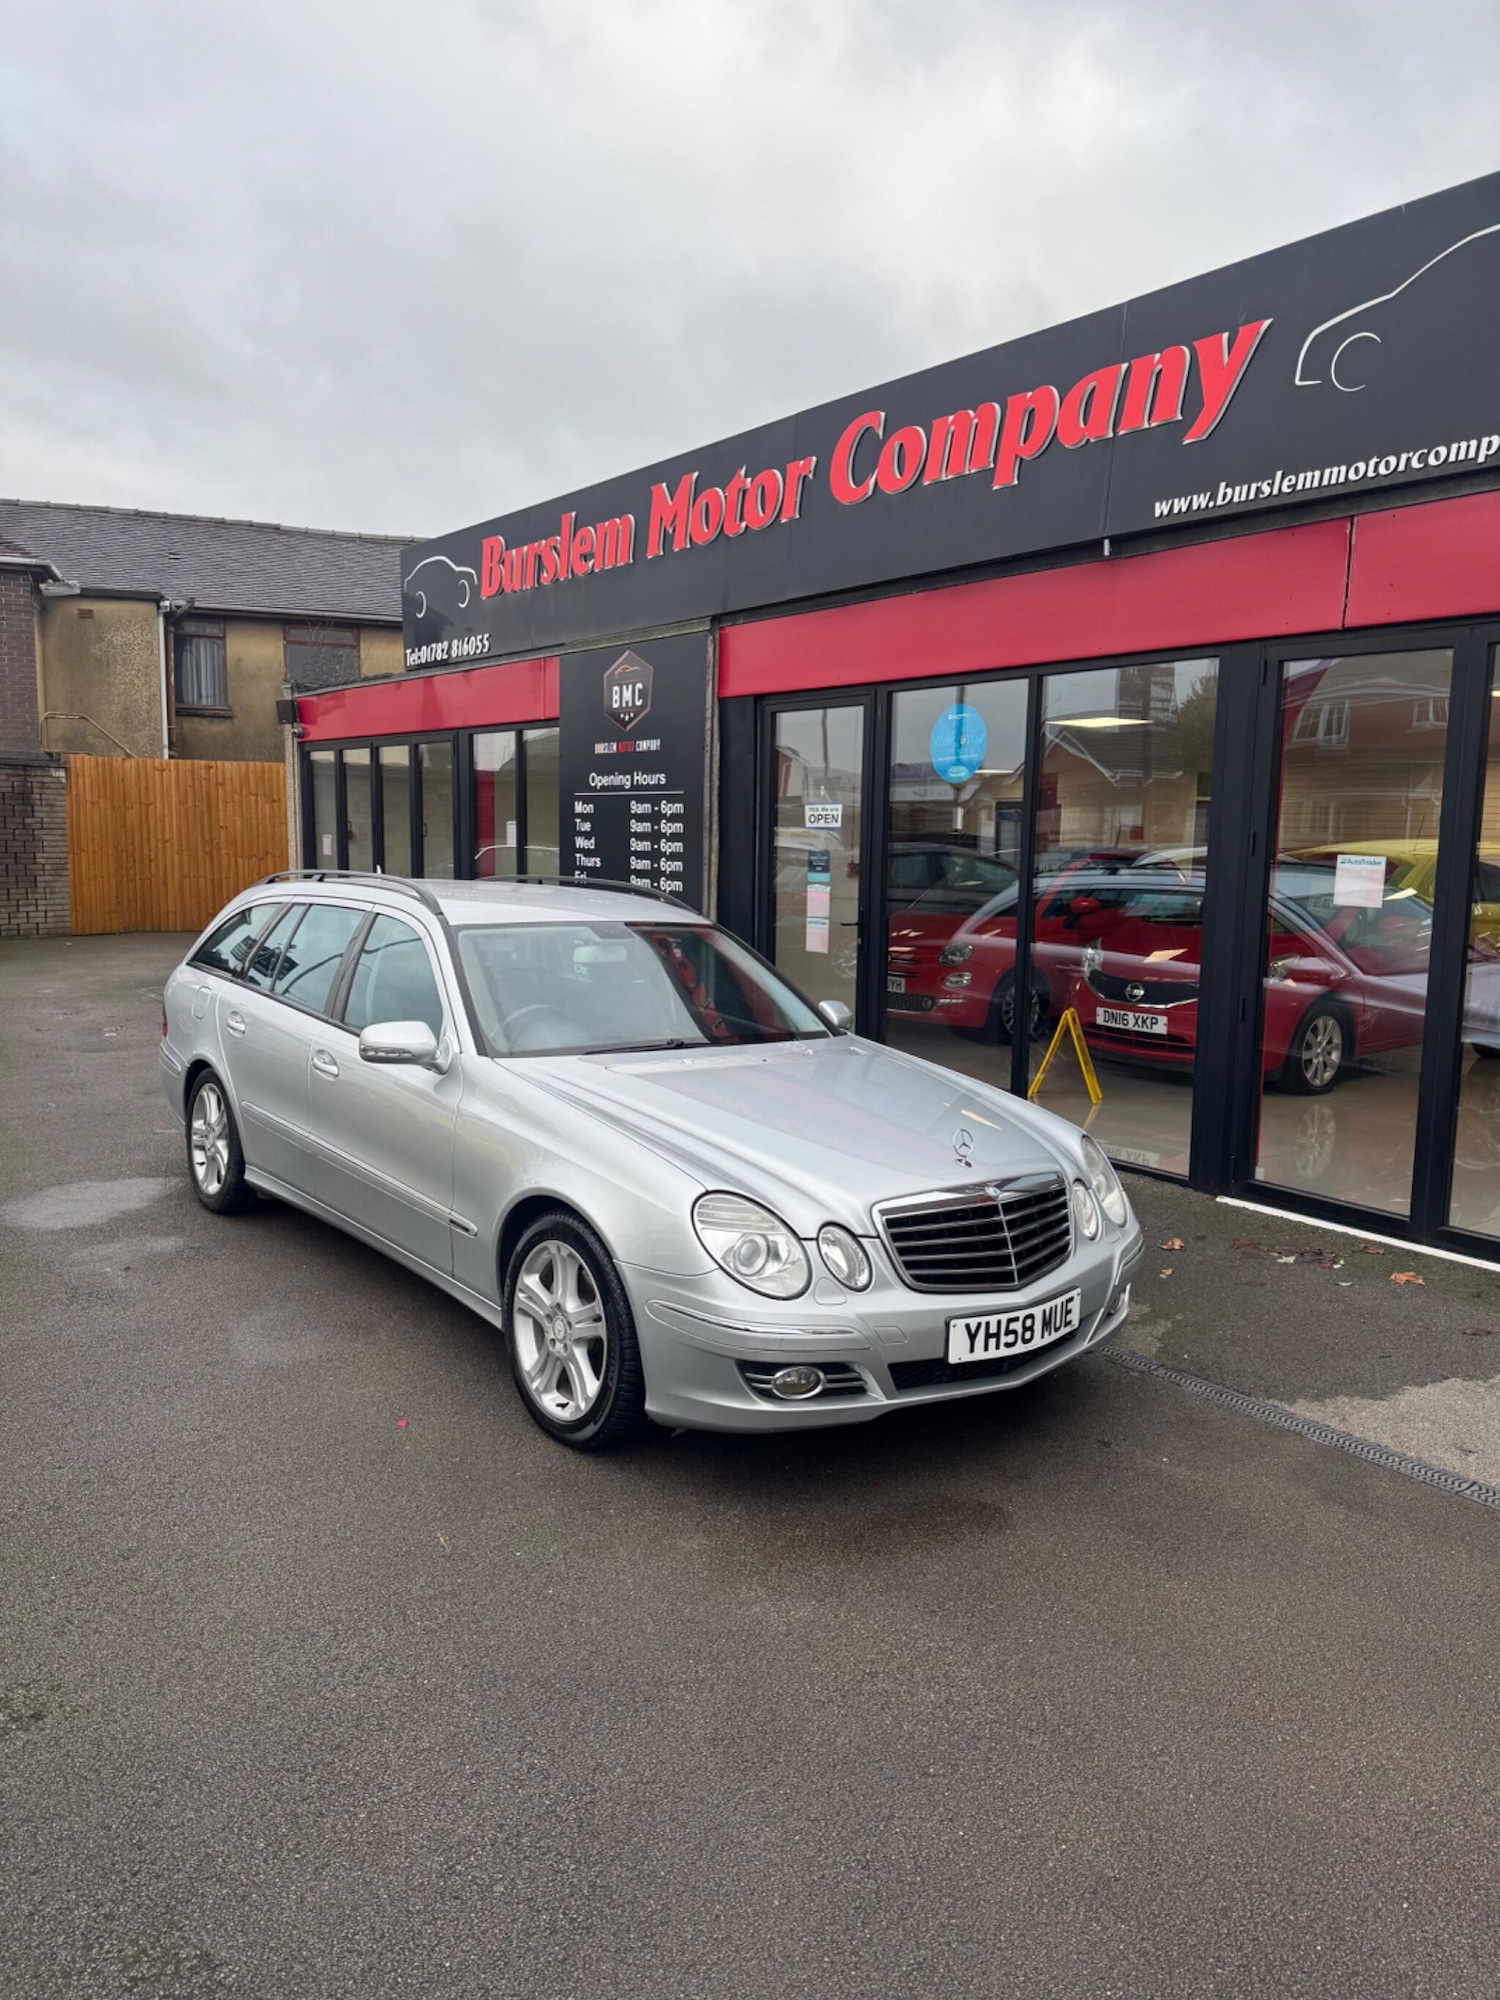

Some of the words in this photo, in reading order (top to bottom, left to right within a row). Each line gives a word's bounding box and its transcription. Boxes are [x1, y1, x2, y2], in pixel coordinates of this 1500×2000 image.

[479, 511, 636, 600] Burslem
[645, 456, 818, 560] Motor
[829, 317, 1275, 506] Company
[406, 641, 449, 667] Tel:01782
[451, 633, 491, 658] 816055
[612, 682, 643, 709] BMC
[588, 771, 632, 790] Opening
[633, 770, 667, 786] Hours
[574, 801, 595, 814] Mon
[629, 800, 652, 814] 9am
[660, 800, 684, 817] 6pm
[808, 813, 840, 824] OPEN
[574, 818, 592, 832] Tue
[629, 819, 652, 832] 9am
[660, 819, 684, 836] 6pm
[574, 836, 596, 849] Wed
[629, 838, 652, 852] 9am
[660, 839, 684, 855] 6pm
[574, 853, 601, 867] Thurs
[629, 856, 652, 870] 9am
[660, 857, 684, 874] 6pm
[629, 875, 652, 889] 9am
[660, 877, 684, 893] 6pm
[1103, 1009, 1130, 1027] DN16
[1132, 1013, 1159, 1031] XKP
[964, 1312, 1036, 1354] YH58
[1040, 1295, 1075, 1340] MUE
